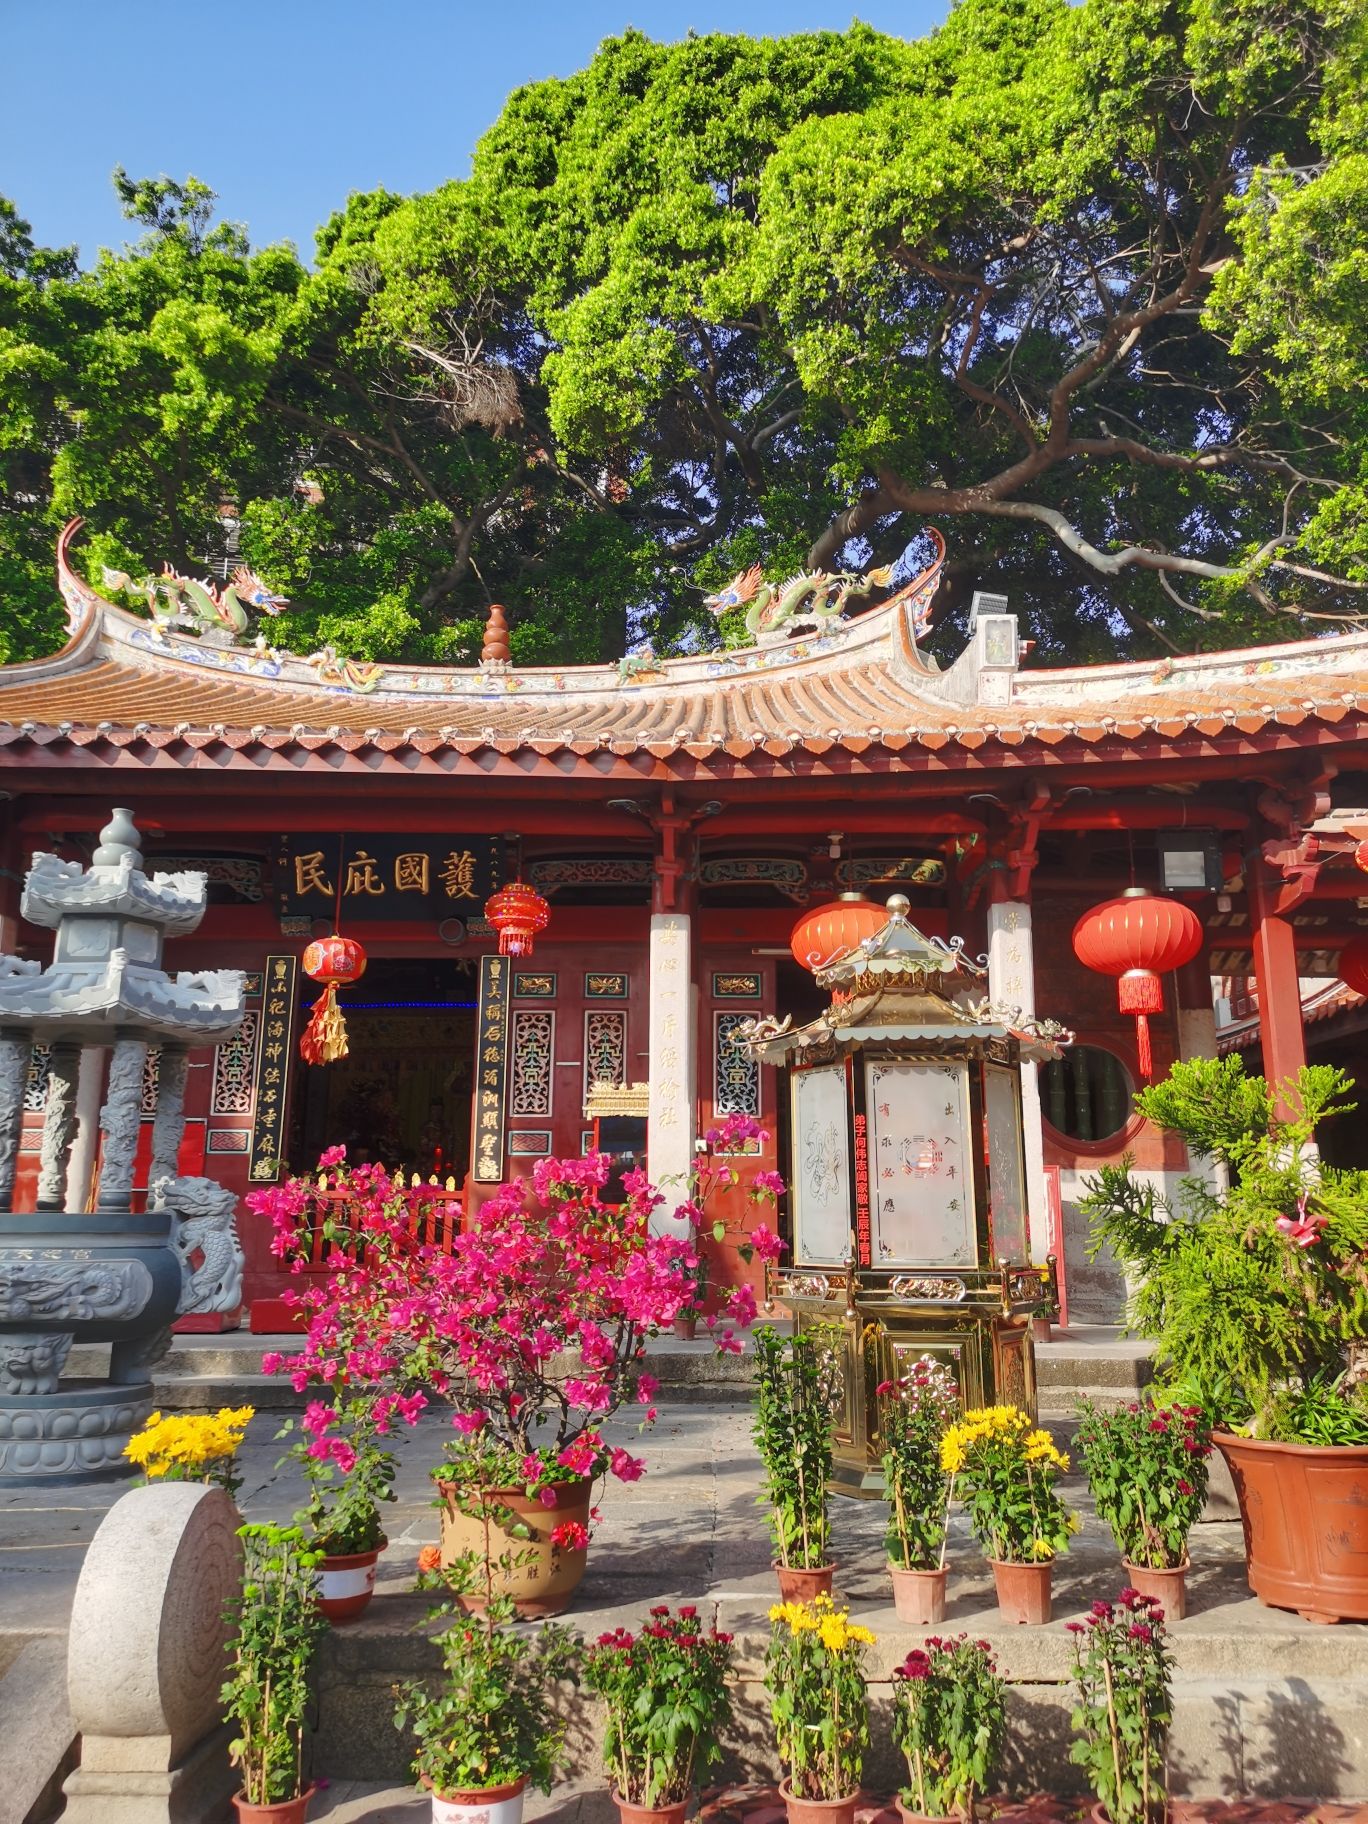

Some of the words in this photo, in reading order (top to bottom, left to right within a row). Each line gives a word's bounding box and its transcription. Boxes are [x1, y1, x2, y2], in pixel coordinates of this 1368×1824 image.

[295, 851, 480, 899] 護國庇民
[944, 1102, 961, 1212] 出入平安
